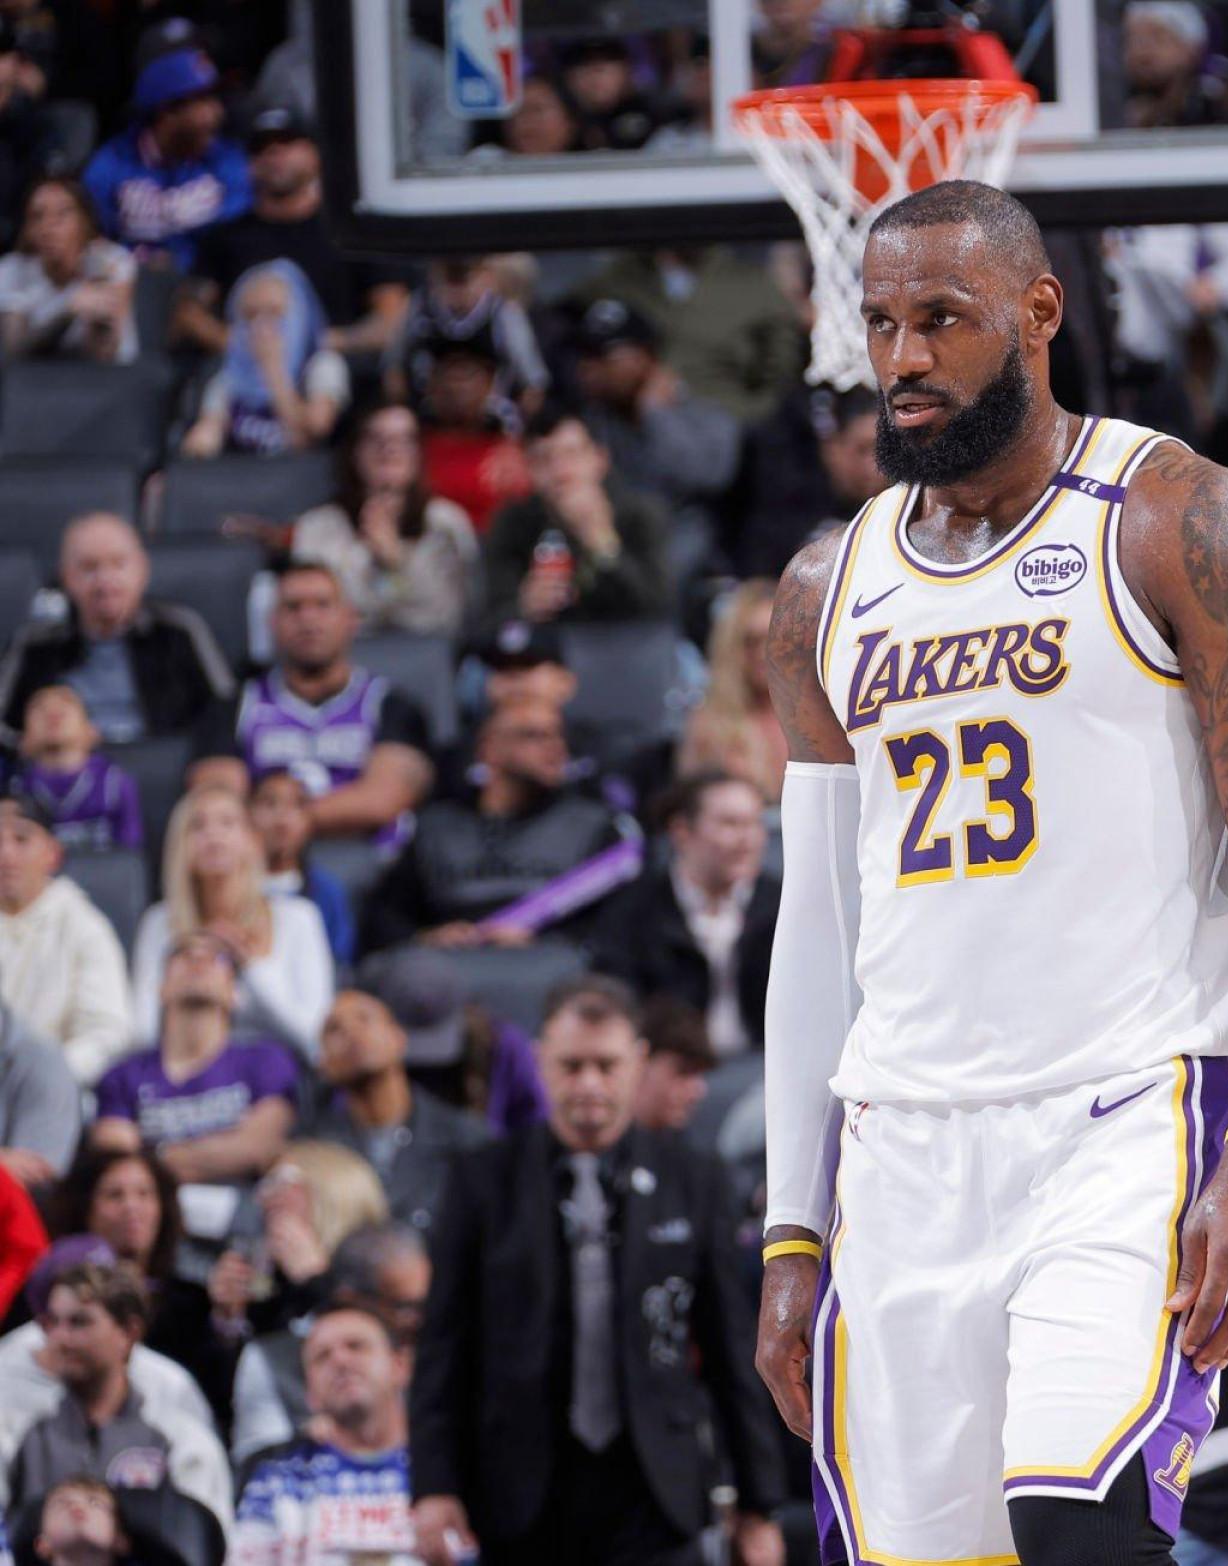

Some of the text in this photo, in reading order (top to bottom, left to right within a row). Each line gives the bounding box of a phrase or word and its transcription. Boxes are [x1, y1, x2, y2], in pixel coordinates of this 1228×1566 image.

[1078, 479, 1101, 495] 44
[1021, 558, 1083, 580] bibigo
[846, 617, 1072, 735] LAKERS
[881, 715, 1040, 888] 23
